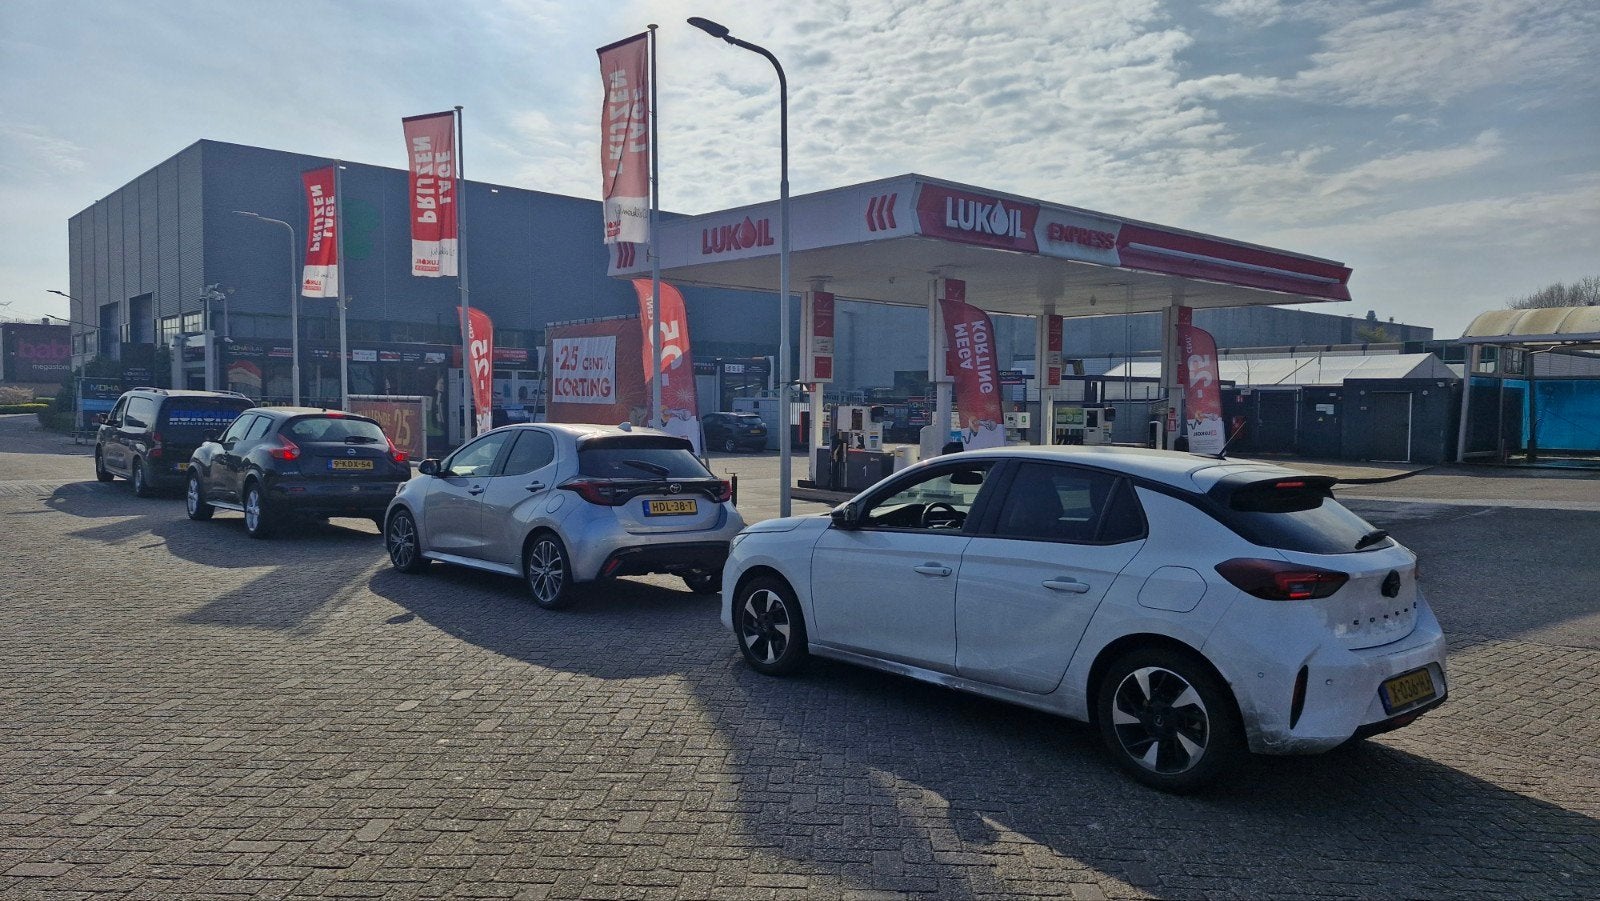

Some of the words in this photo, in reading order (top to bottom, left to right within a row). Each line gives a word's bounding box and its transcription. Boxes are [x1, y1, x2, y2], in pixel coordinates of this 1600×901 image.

[946, 196, 1026, 239] LUKOIL
[702, 216, 774, 254] LUKOIL
[1047, 222, 1115, 250] EXPRESS
[32, 363, 70, 371] megastore
[555, 345, 579, 371] -25
[554, 377, 611, 398] KORTING
[394, 408, 411, 446] 25
[333, 459, 371, 468] 9-KDX-54
[862, 465, 867, 477] 1
[652, 501, 693, 512] HDL-38-T
